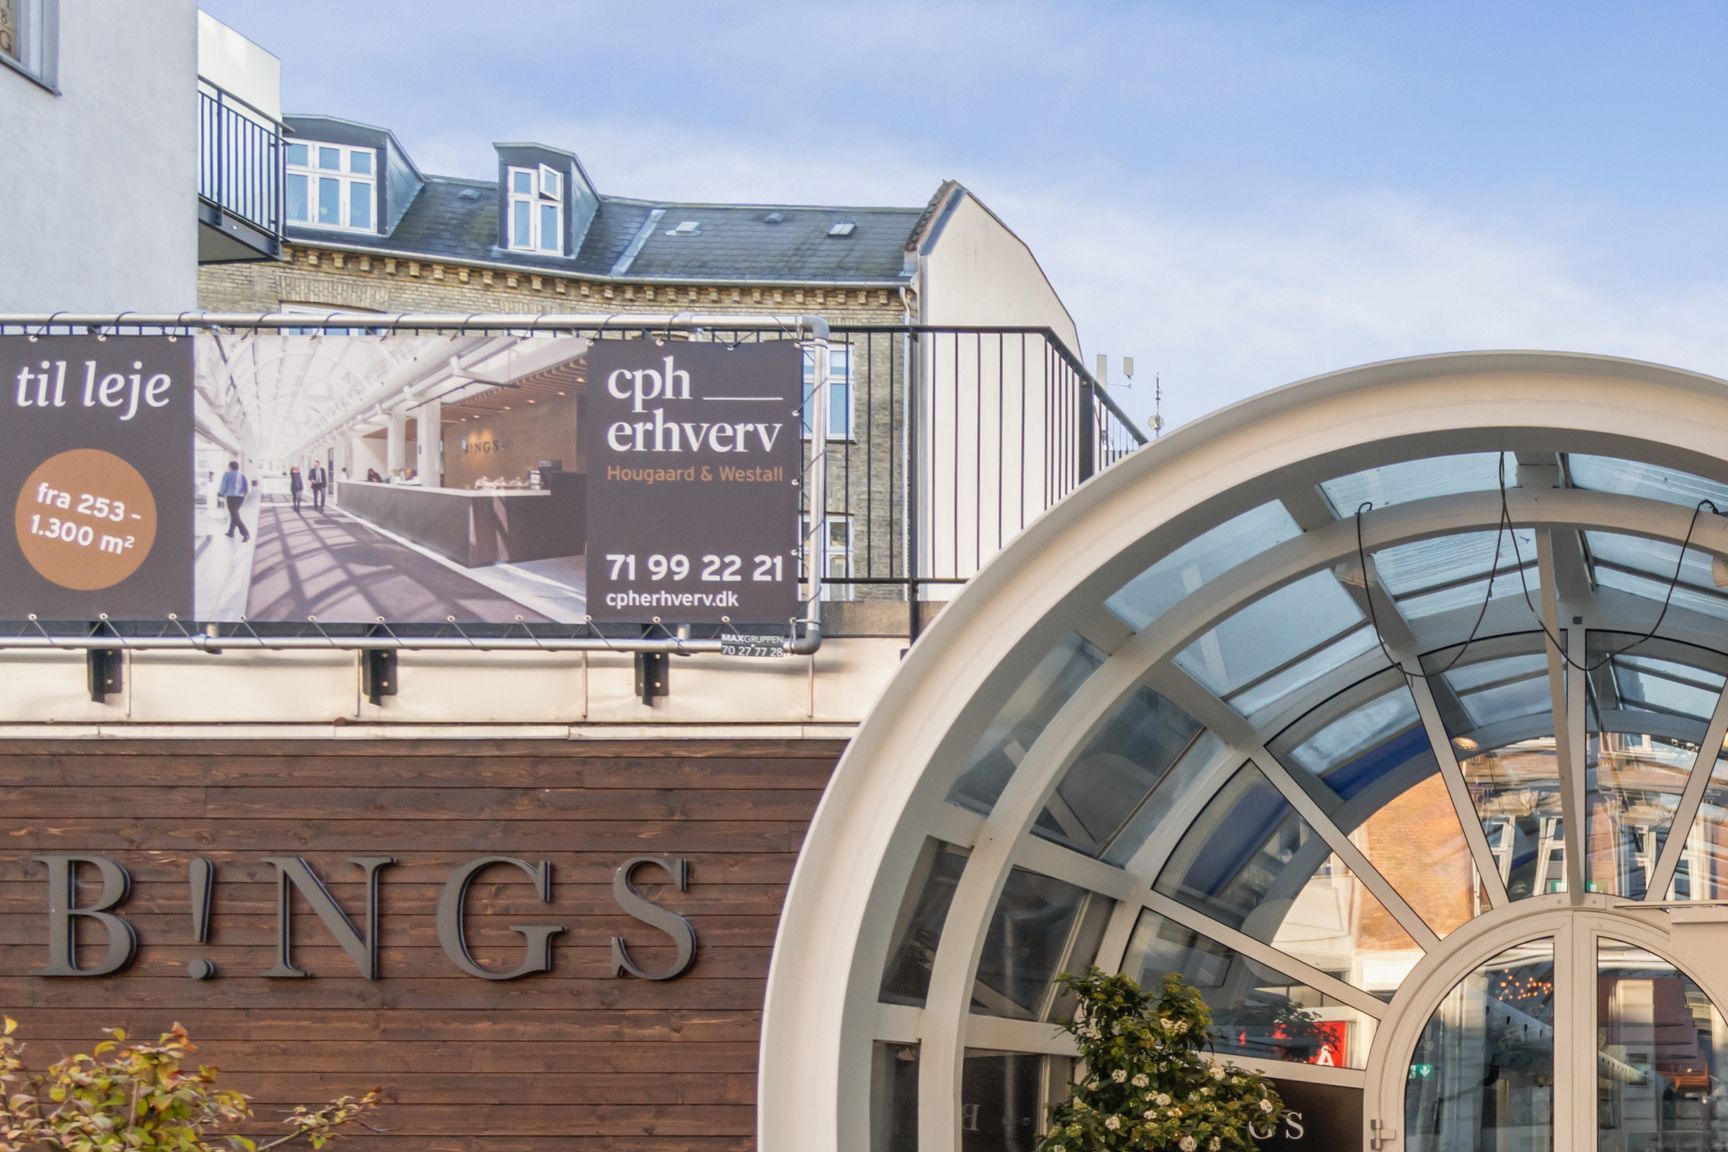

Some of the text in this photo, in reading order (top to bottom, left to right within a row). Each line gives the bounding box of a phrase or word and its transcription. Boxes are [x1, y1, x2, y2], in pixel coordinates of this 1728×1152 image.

[16, 360, 171, 421] til leje
[607, 355, 693, 413] cph
[607, 408, 783, 453] erhverv
[607, 465, 784, 485] Hougaard & Westall
[37, 482, 71, 510] fra
[77, 493, 126, 523] 253
[31, 514, 94, 547] 1.300
[606, 554, 784, 582] 71 99 22 21
[606, 590, 740, 610] cpherhverv.dk
[721, 633, 784, 644] MAXGRUPPEN
[721, 645, 784, 658] 70 27 77 28
